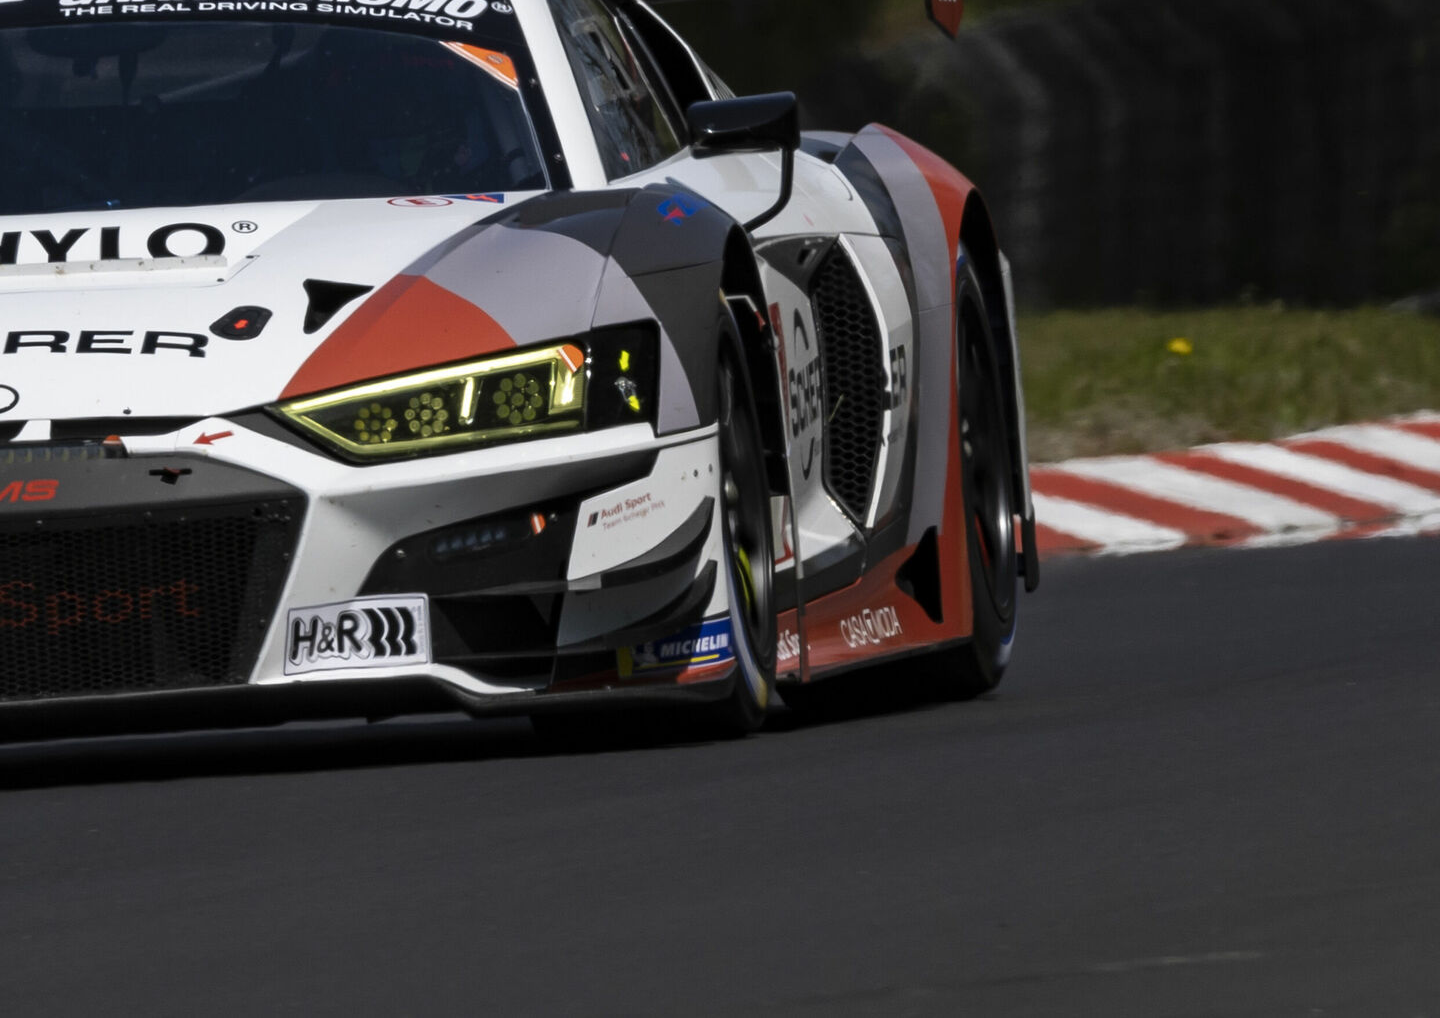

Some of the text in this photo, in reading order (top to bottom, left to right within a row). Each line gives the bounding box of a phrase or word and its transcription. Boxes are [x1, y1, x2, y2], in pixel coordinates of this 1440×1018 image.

[60, 0, 475, 31] THE REAL DRIVING SIMULATOR
[601, 502, 623, 520] Audi
[625, 492, 651, 512] Sport
[291, 612, 363, 661] H&R
[660, 633, 729, 658] MICHELIN
